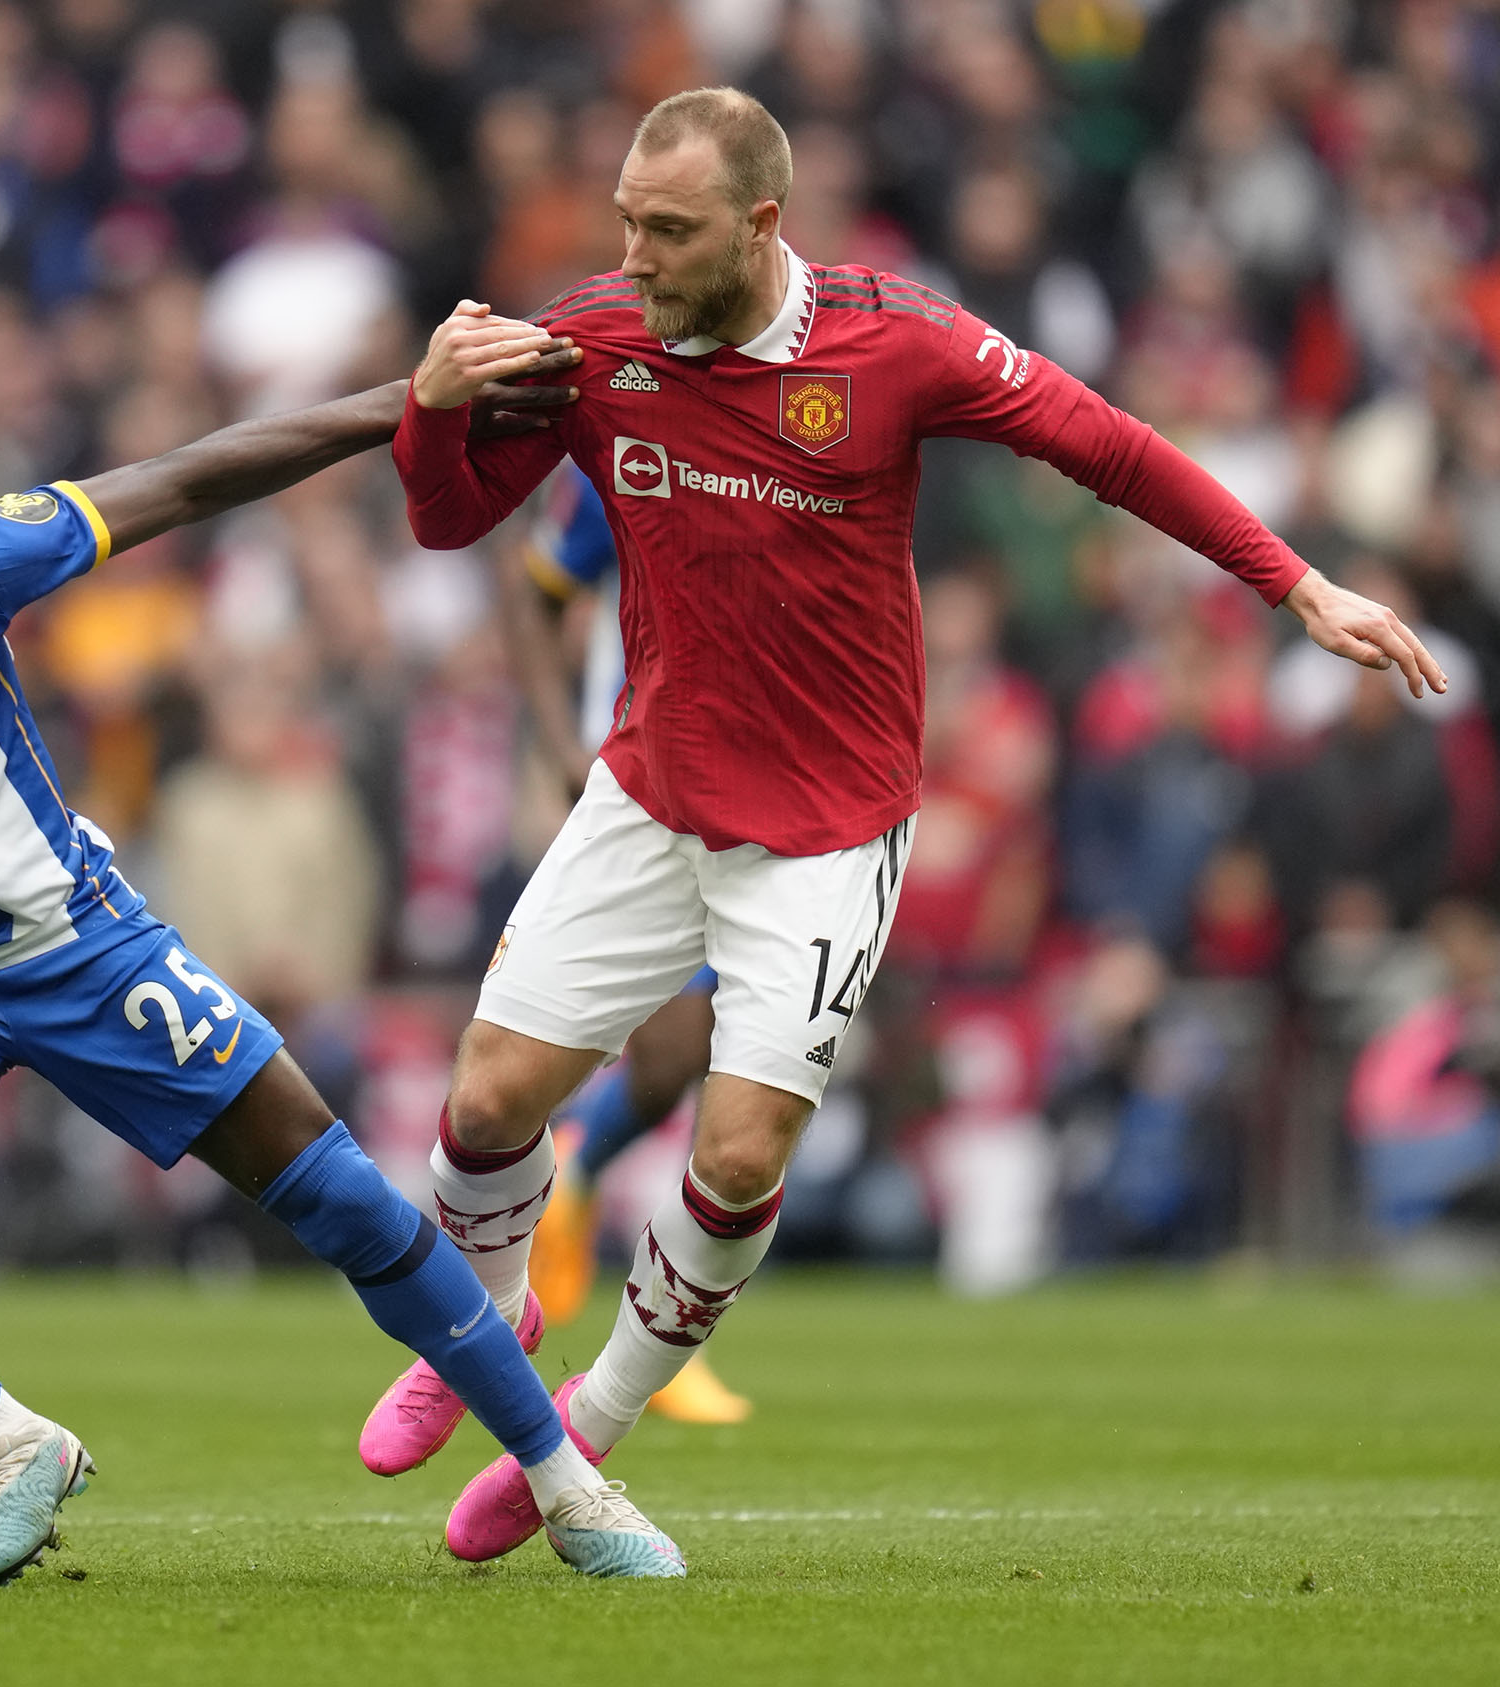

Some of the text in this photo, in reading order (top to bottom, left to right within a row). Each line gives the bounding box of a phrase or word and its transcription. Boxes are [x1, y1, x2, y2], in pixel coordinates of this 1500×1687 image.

[609, 376, 661, 392] adidas
[792, 387, 839, 406] MANCHESTER
[798, 426, 831, 438] UNITED
[672, 460, 847, 514] TeamViewer
[807, 937, 866, 1033] 14
[124, 946, 237, 1067] 25
[805, 1050, 833, 1069] adida
